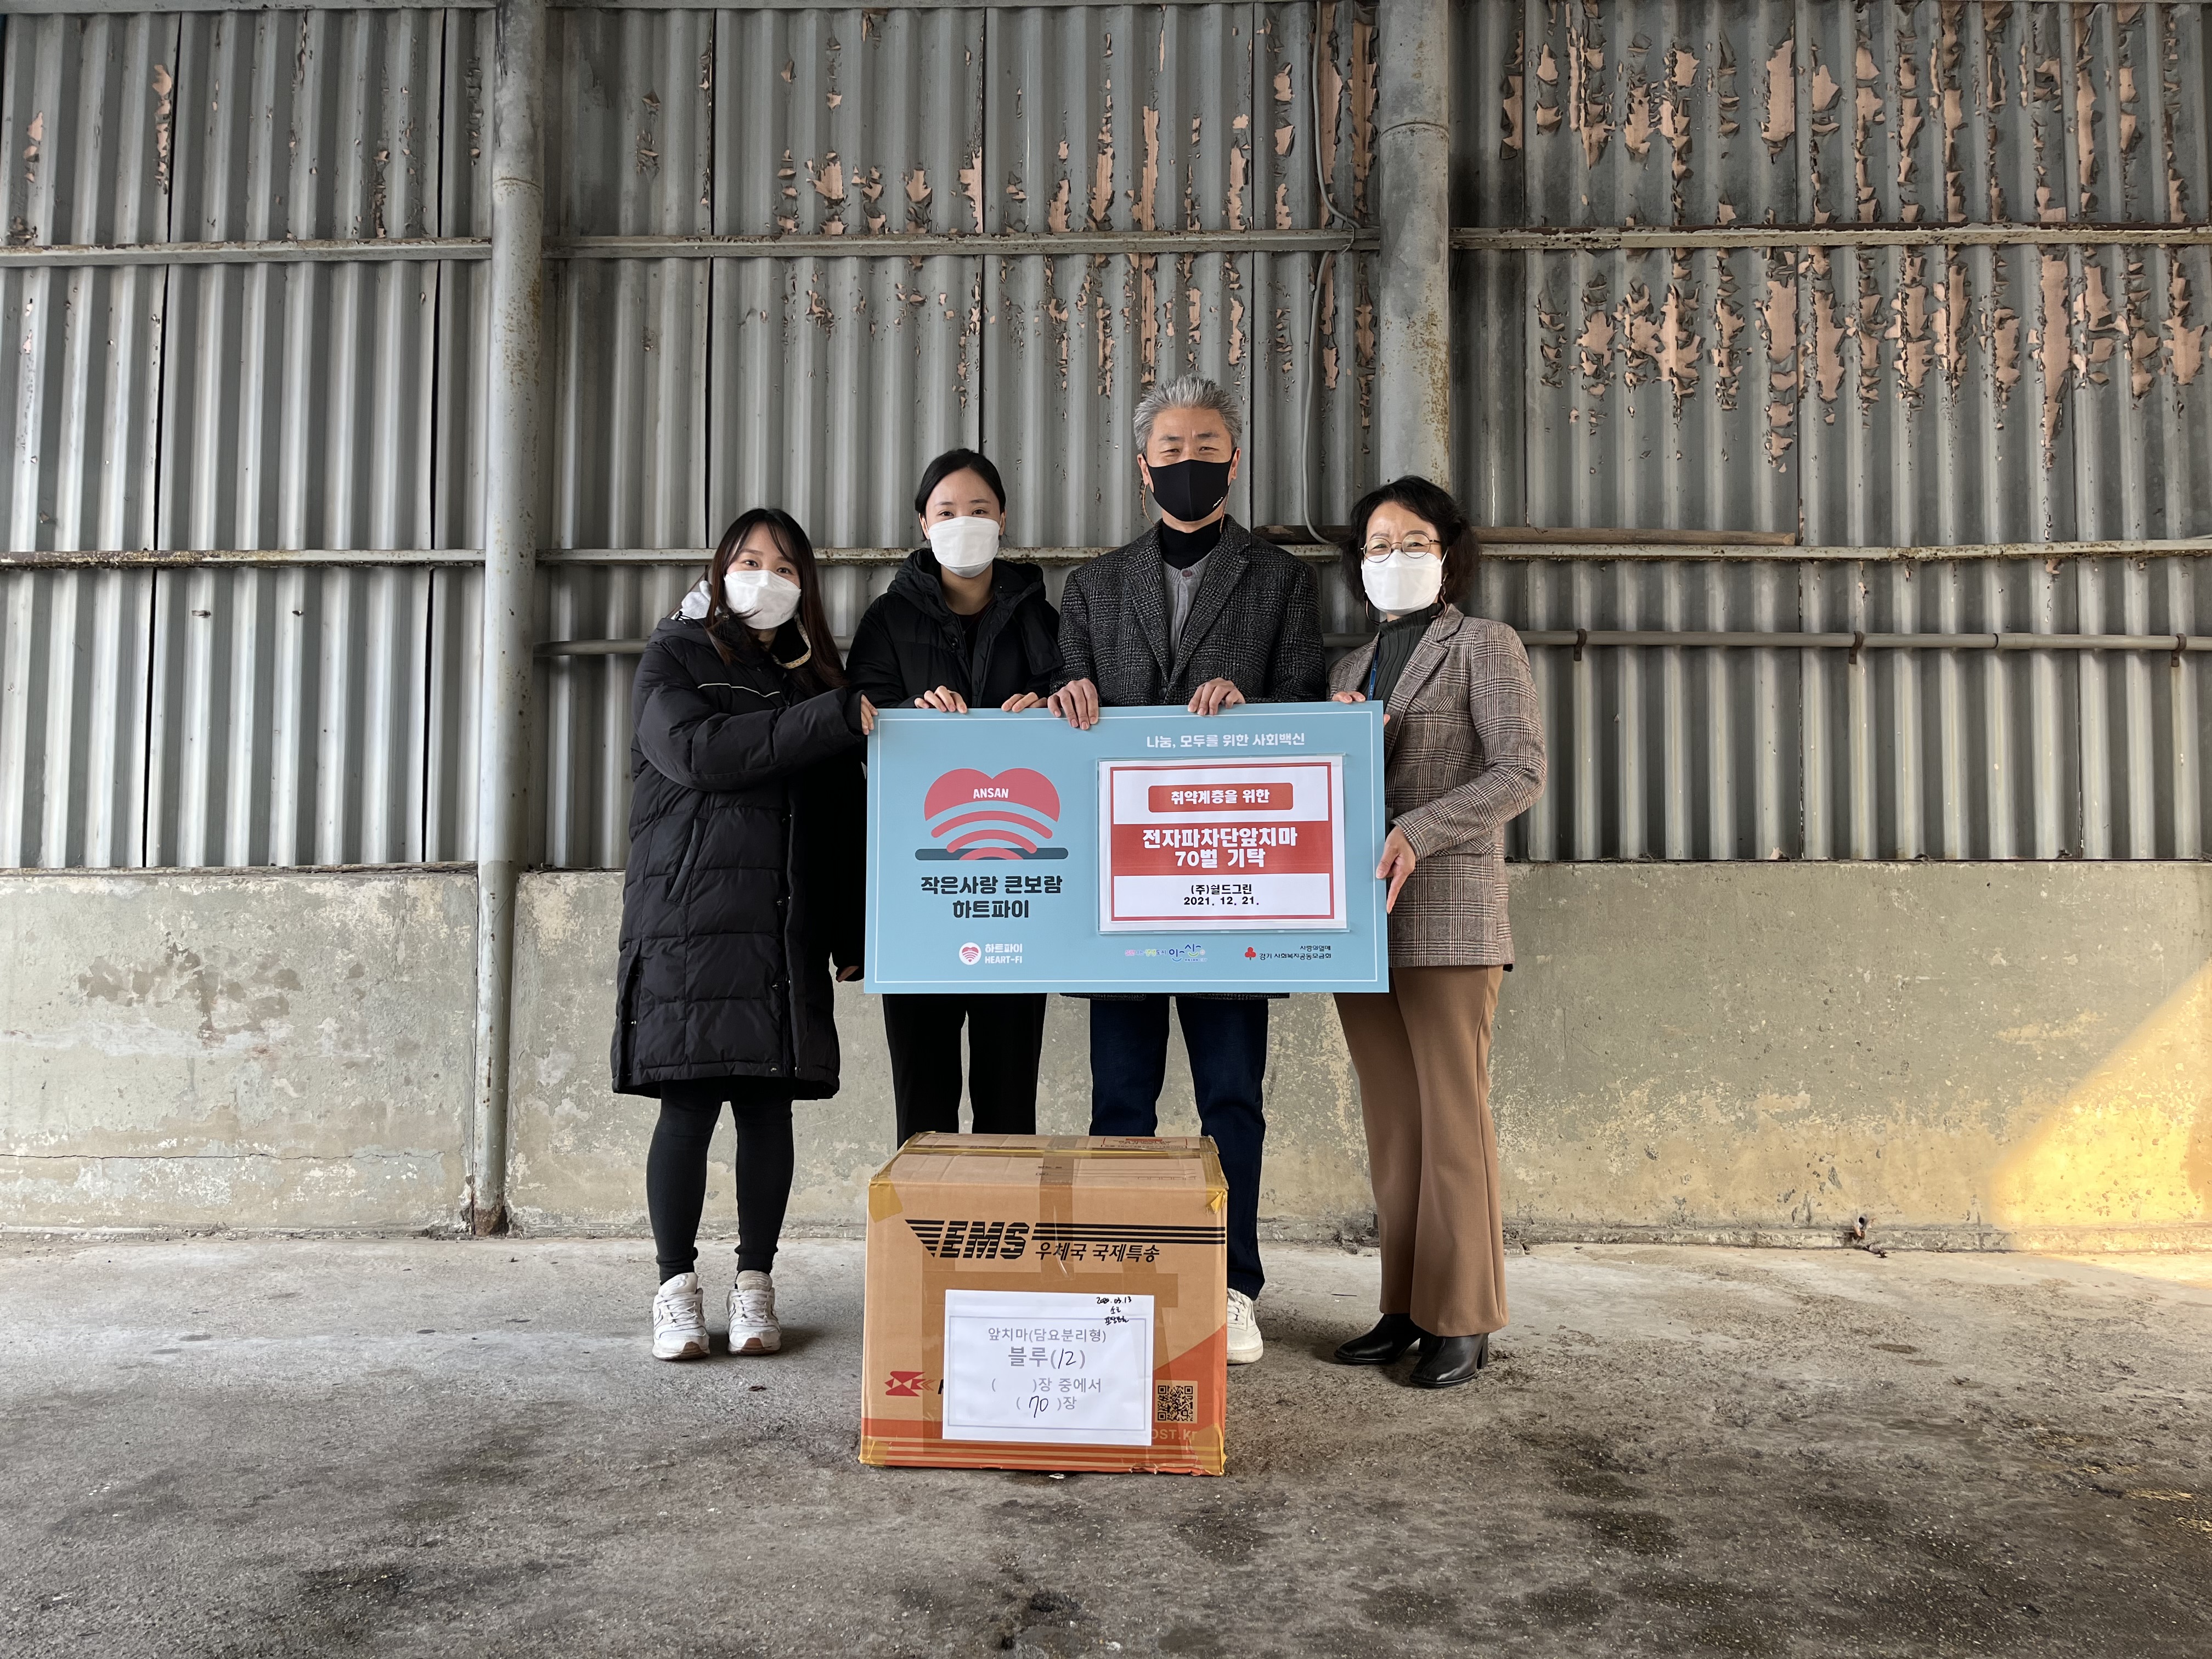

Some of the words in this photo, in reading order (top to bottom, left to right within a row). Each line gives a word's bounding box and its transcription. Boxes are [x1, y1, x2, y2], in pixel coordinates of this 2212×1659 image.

[1147, 736, 1176, 748] 나눔,
[1180, 734, 1218, 747] 모두를
[1222, 733, 1249, 747] 위한
[1252, 732, 1305, 746] 사회백신
[973, 788, 1009, 799] ANSAN
[1171, 789, 1238, 805] 취약계층을
[1242, 789, 1270, 804] 위한
[1143, 827, 1297, 848] 전자파차단앞치마
[1175, 849, 1217, 868] 70벌
[1227, 848, 1266, 867] 기탁
[921, 876, 998, 894] 작은사랑
[1005, 876, 1063, 894] 큰보람
[1191, 884, 1252, 895] (주)쉴드그린
[952, 900, 1029, 918] 하트파이
[1184, 896, 1215, 906] 2021.
[1220, 896, 1237, 905] 12.
[1242, 896, 1259, 905] 21.
[985, 943, 1023, 953] 하트파이
[985, 956, 1022, 964] HEART-FI
[940, 1220, 1030, 1260] EMS
[1035, 1242, 1087, 1261] 우체국
[1092, 1243, 1160, 1263] 국제특송
[988, 1328, 1107, 1343] 앞치마(담요분리형)
[1058, 1378, 1101, 1393] 중에서
